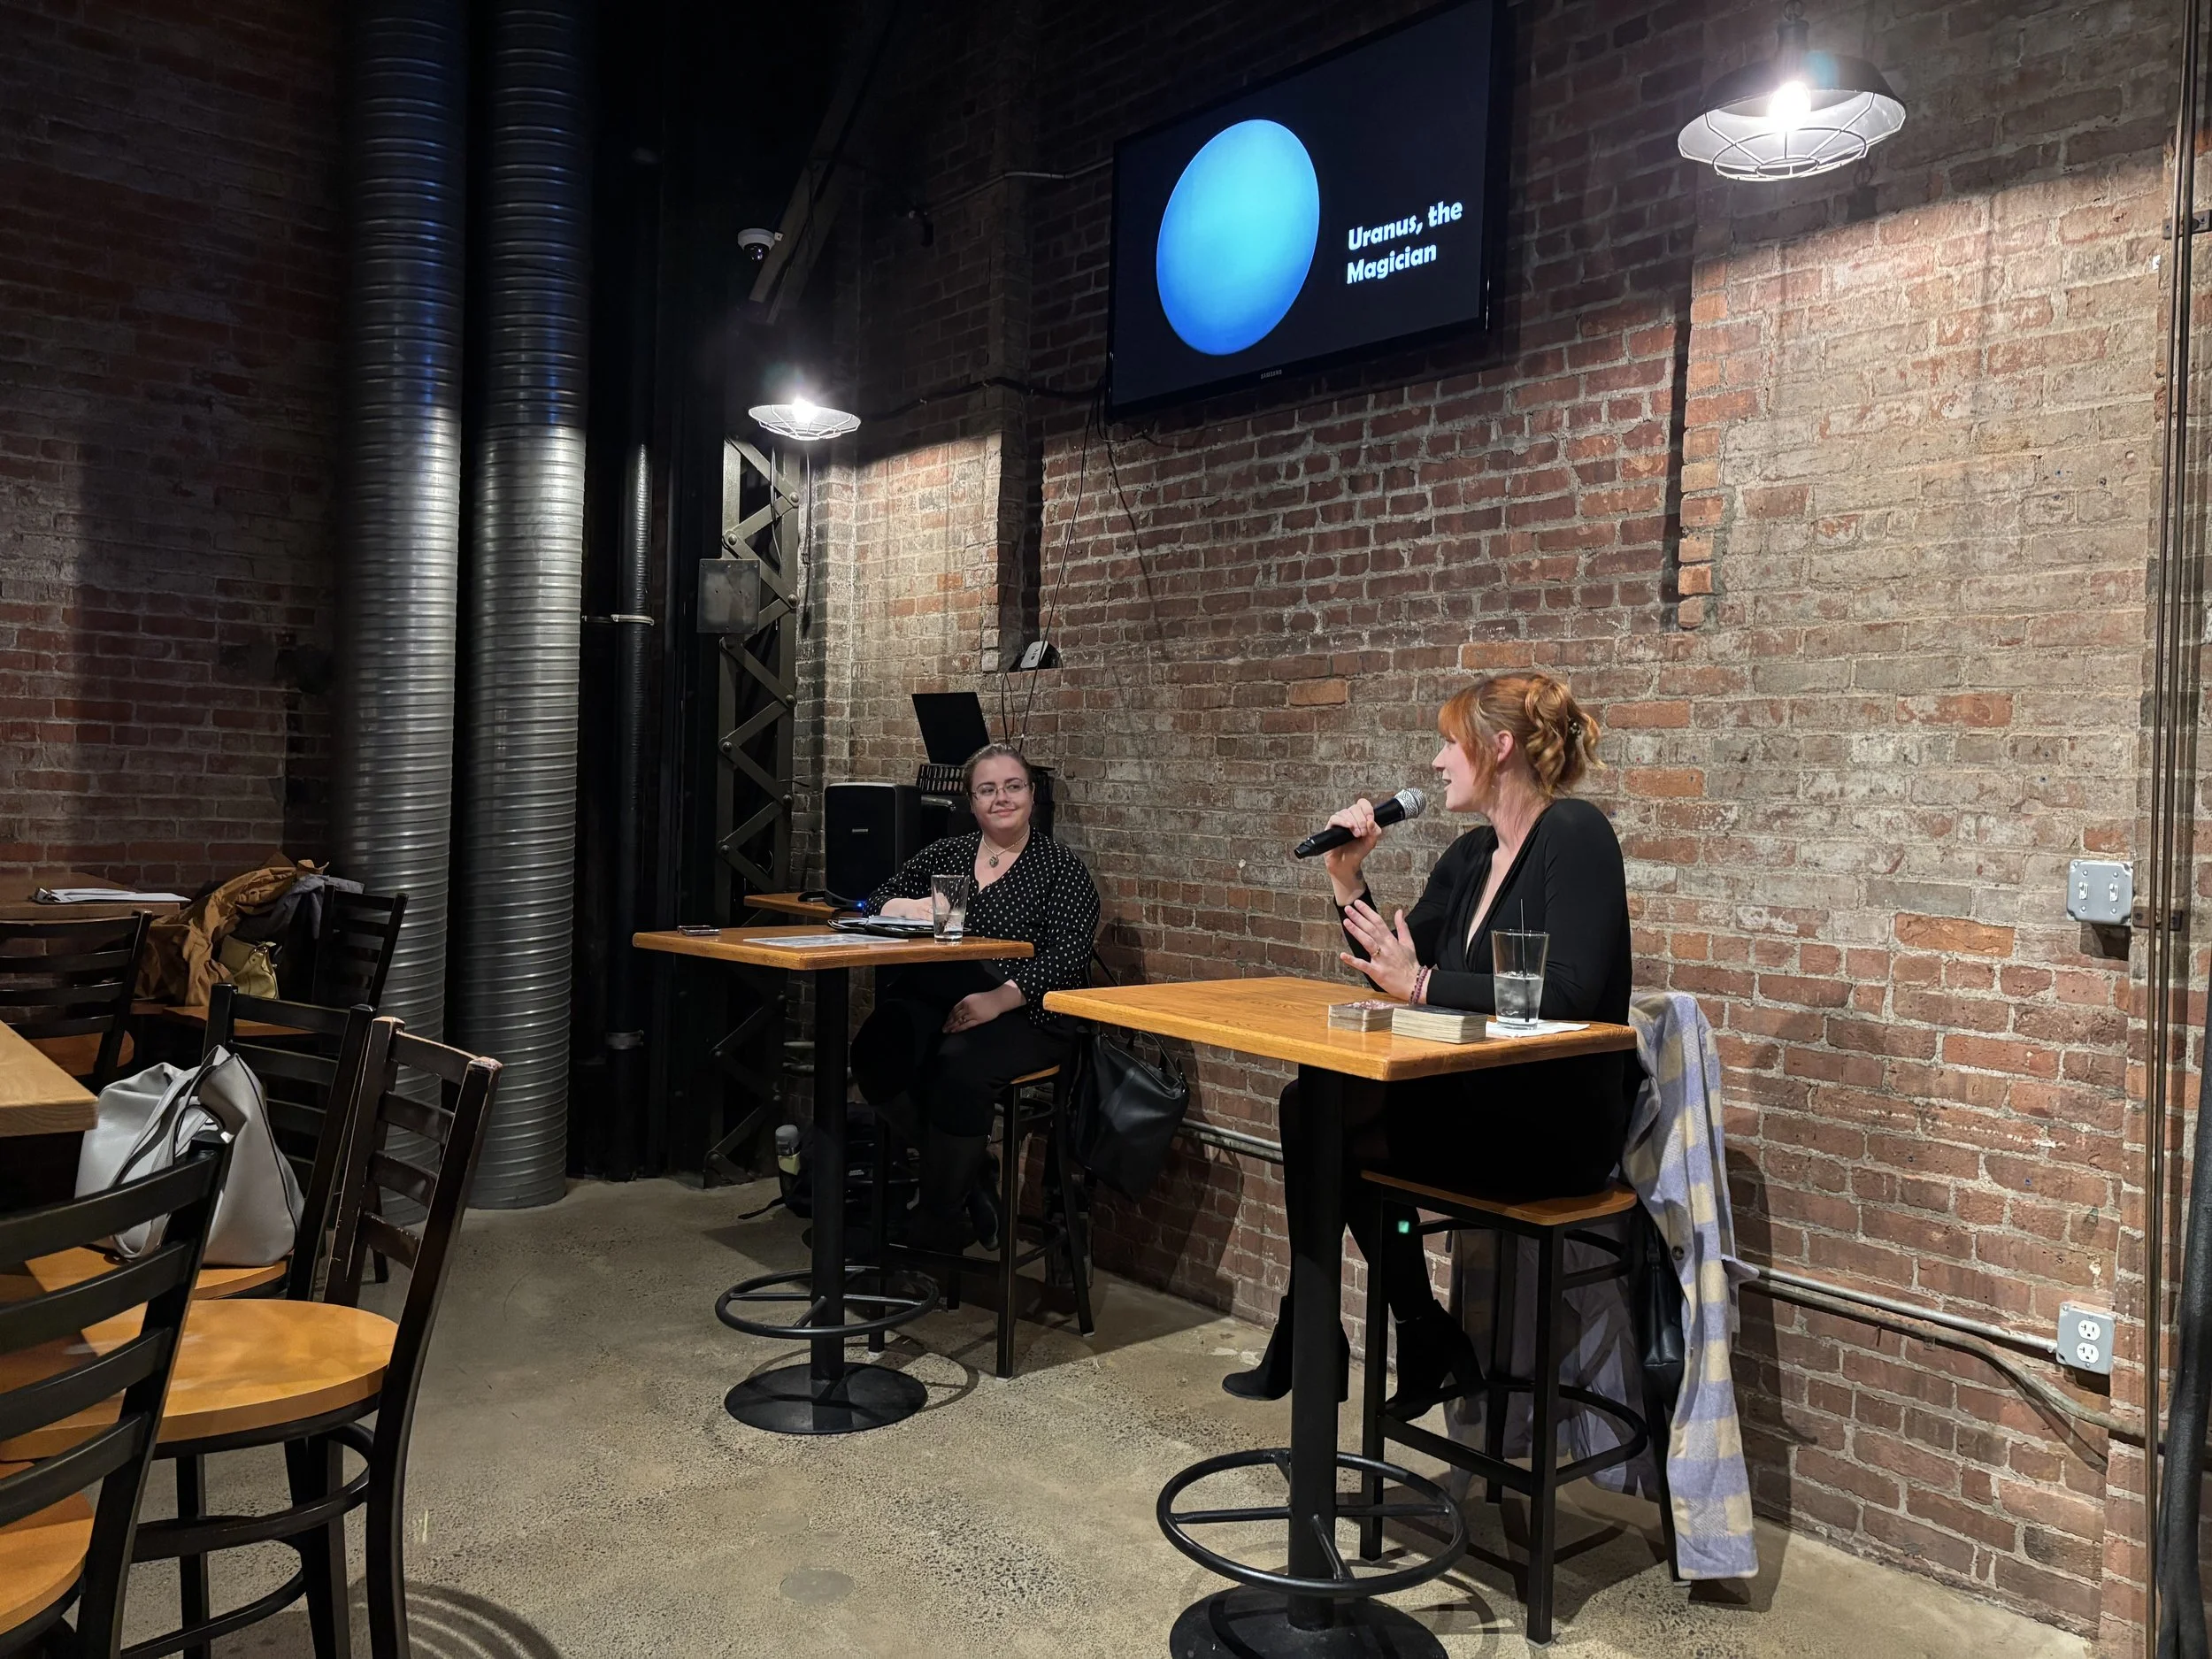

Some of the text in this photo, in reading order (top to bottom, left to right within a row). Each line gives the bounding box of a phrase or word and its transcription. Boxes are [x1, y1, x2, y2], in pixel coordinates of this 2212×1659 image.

[1348, 201, 1463, 250] Uranus, the
[1347, 244, 1437, 284] Magician
